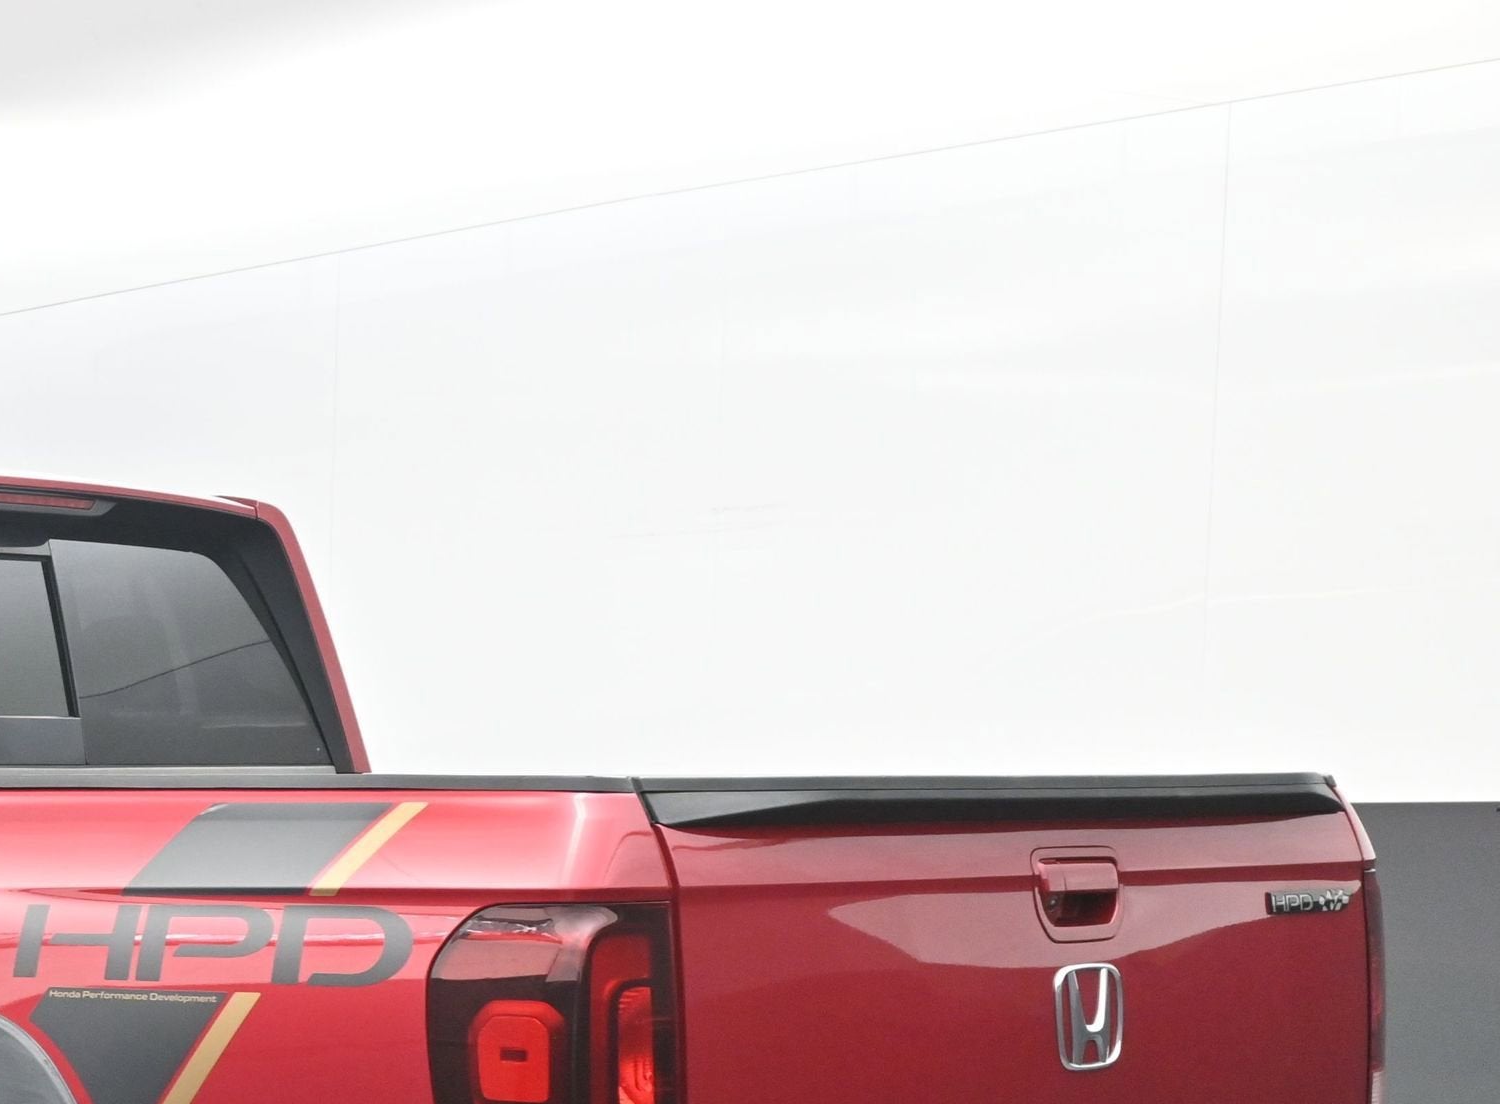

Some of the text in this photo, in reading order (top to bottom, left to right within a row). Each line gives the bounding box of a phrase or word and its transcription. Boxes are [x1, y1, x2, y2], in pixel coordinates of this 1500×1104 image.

[1272, 893, 1313, 912] HPD
[13, 904, 413, 987] HPD
[49, 989, 217, 1004] Honda Performance Development
